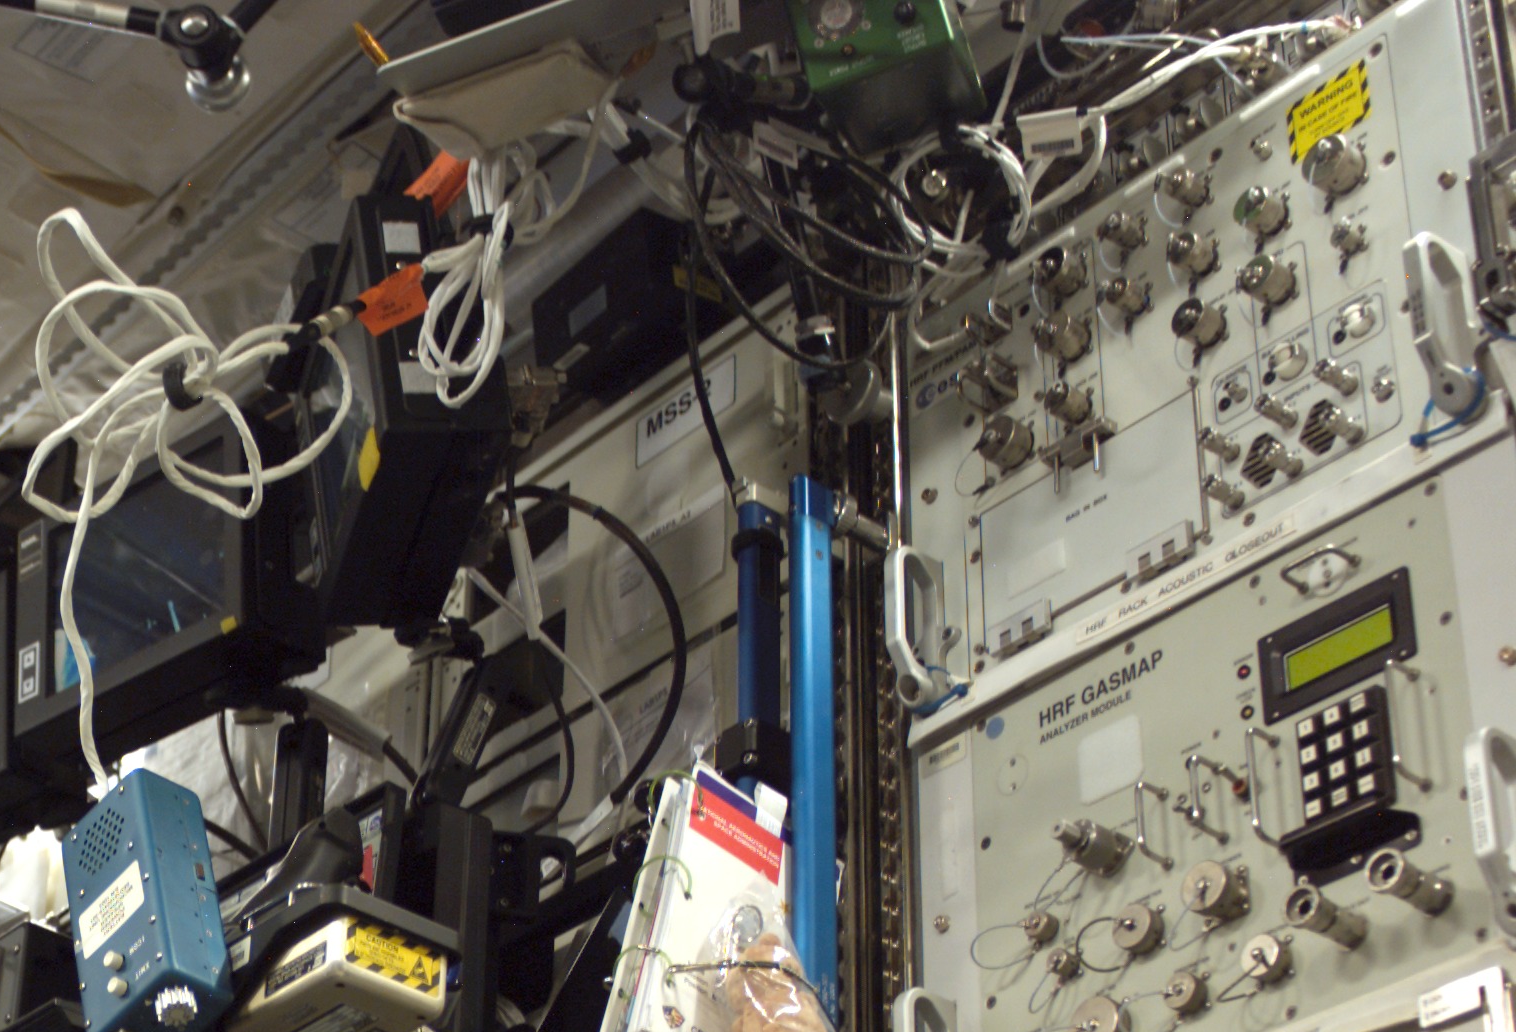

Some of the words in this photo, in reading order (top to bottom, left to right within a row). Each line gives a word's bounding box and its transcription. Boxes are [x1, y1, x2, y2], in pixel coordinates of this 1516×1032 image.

[1300, 80, 1353, 119] WARNING
[1118, 598, 1148, 618] RACK
[1158, 562, 1213, 597] ACOUSTIC
[1225, 522, 1284, 563] CLOSEOUT
[1039, 693, 1076, 728] HRF
[1081, 648, 1163, 706] GASMAP
[1040, 711, 1089, 745] ANALYZER
[1090, 689, 1132, 718] MODULE
